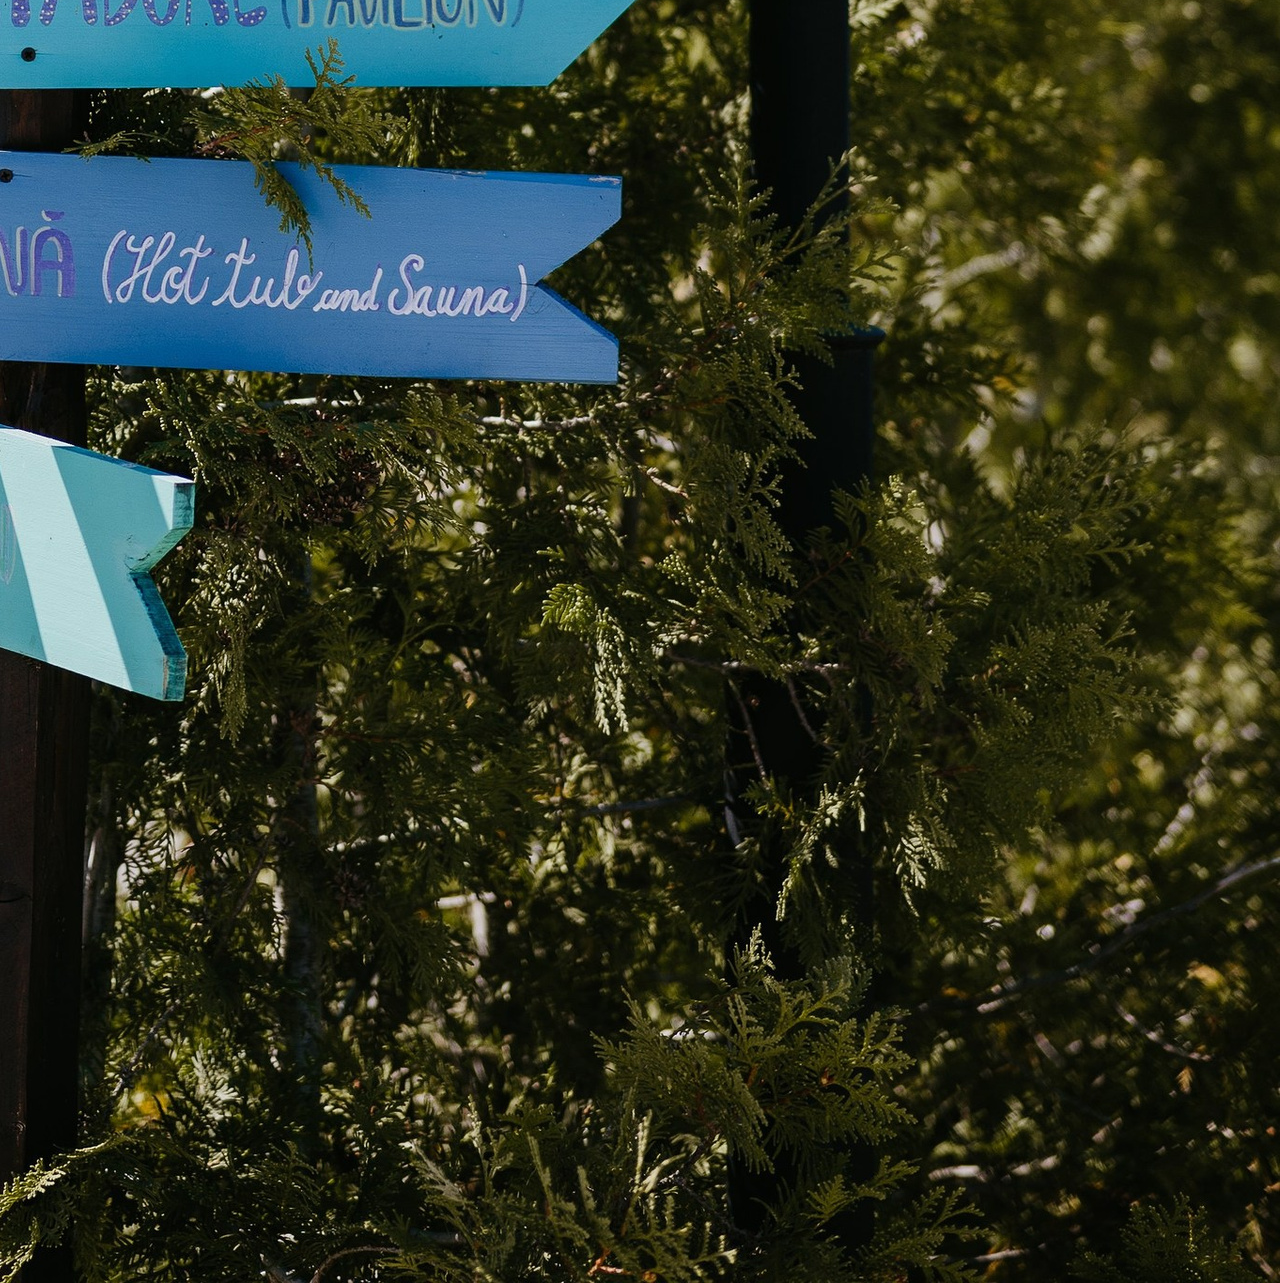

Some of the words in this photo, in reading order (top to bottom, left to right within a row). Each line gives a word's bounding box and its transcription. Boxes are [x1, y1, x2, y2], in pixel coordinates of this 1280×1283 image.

[102, 230, 215, 306] (Hot
[212, 236, 324, 311] tub
[314, 263, 384, 314] and
[387, 253, 528, 323] Sauna)
